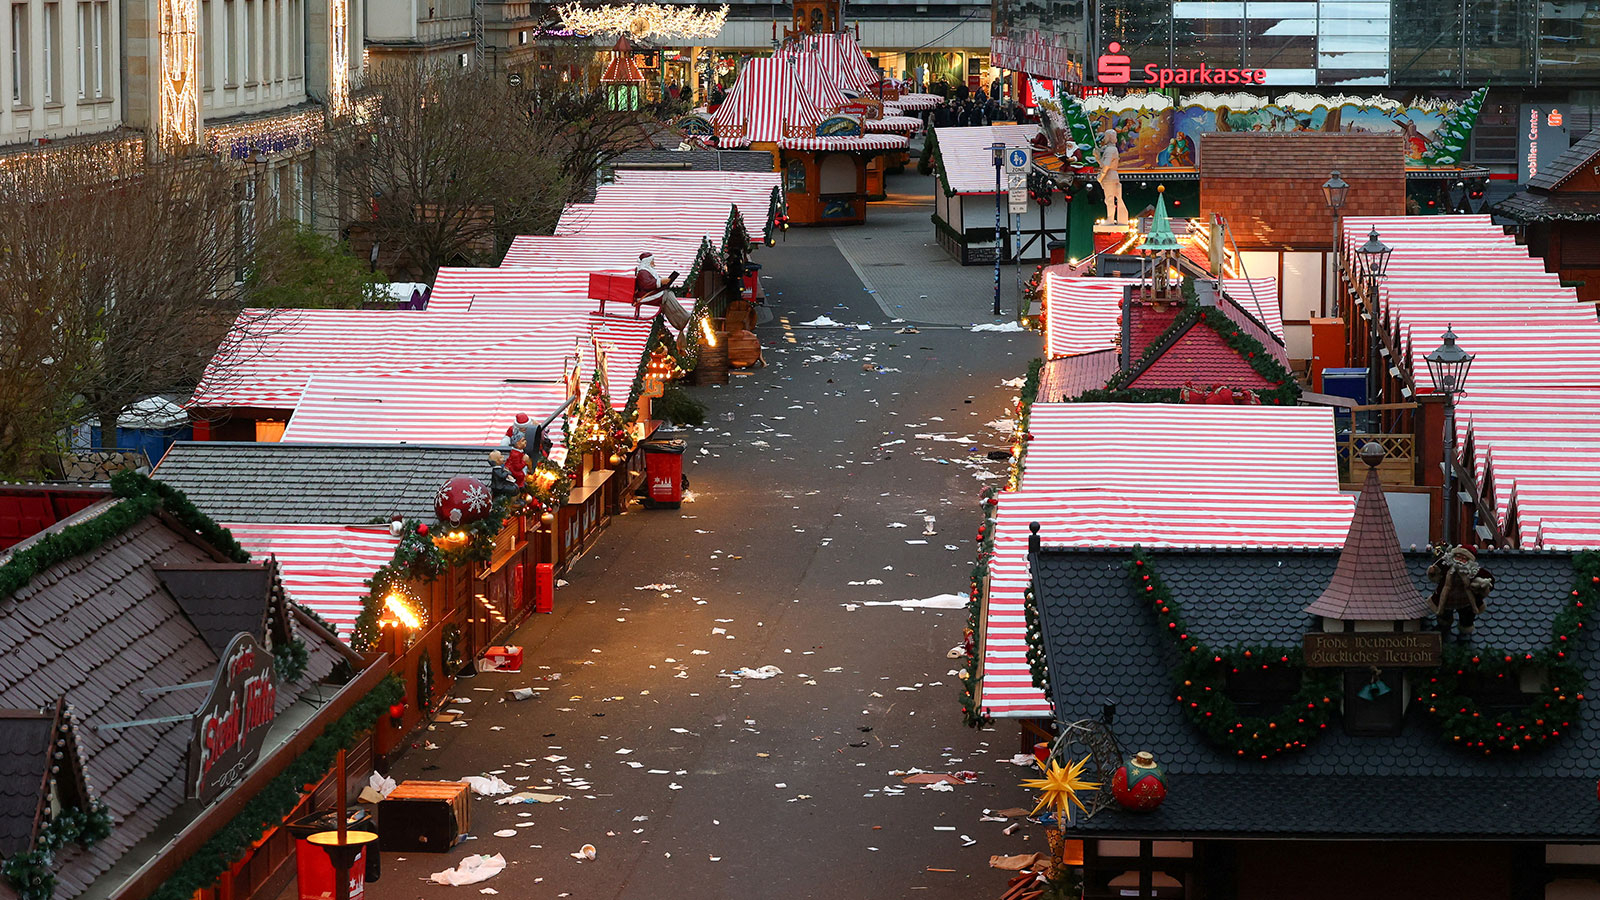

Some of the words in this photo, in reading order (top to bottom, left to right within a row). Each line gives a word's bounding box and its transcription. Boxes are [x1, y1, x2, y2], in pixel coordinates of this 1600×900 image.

[1144, 62, 1267, 89] Sparkasse
[1528, 109, 1539, 140] Center
[1317, 637, 1348, 649] Frohe
[1355, 636, 1417, 649] Weihnacht
[196, 691, 240, 799] Steak
